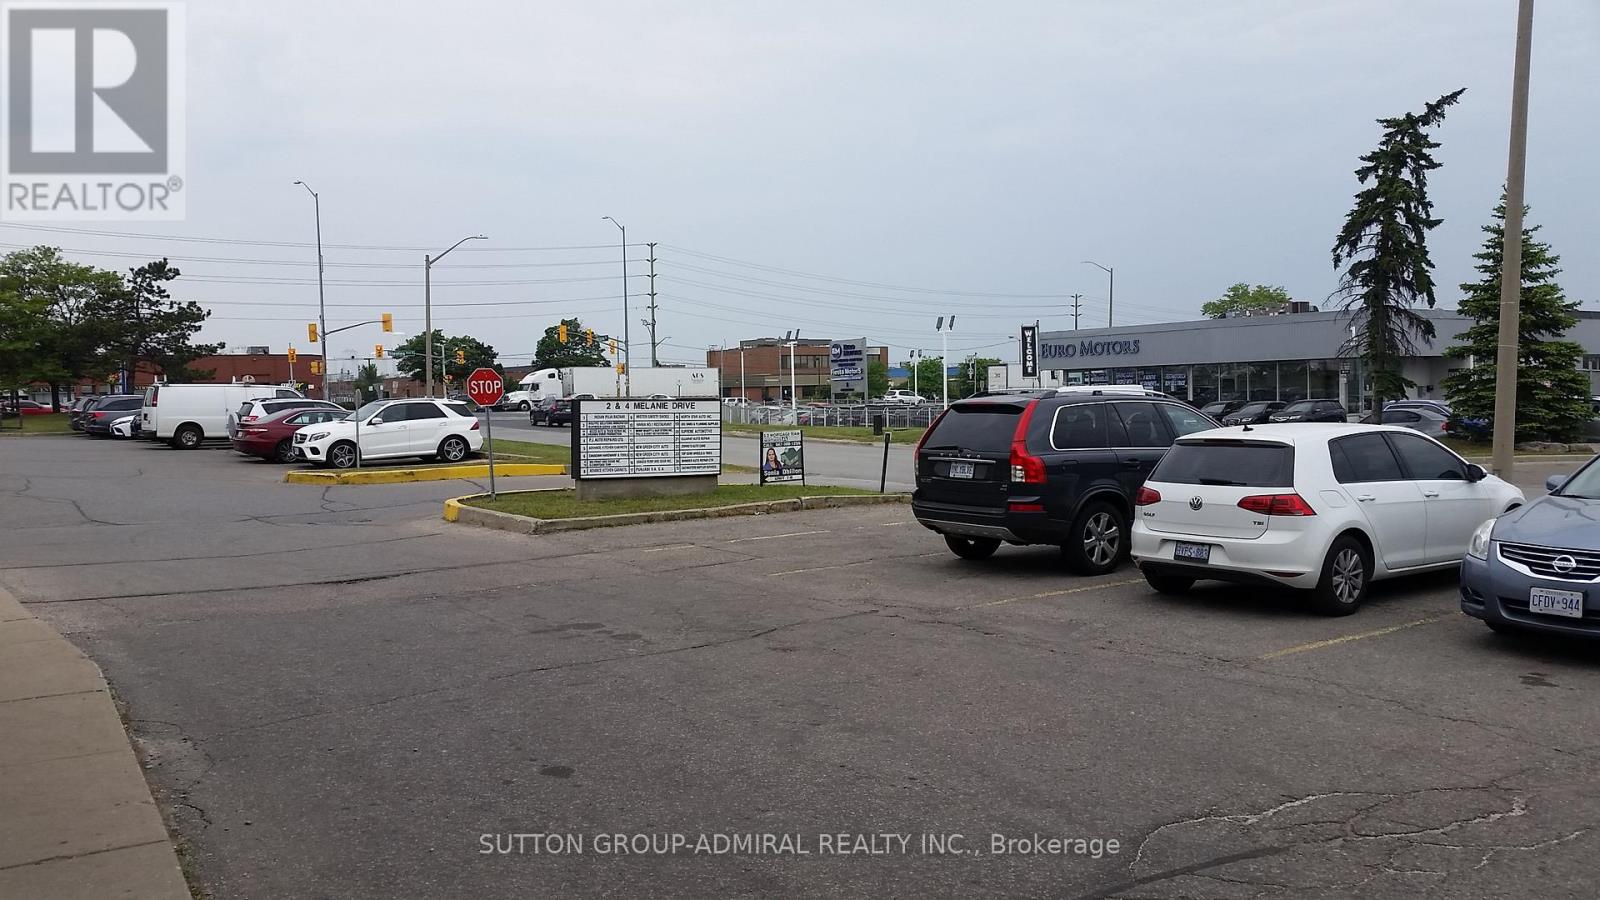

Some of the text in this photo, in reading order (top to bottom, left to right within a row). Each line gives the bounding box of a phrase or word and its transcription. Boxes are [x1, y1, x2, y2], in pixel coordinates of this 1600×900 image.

[1024, 330, 1033, 373] WELCOME
[1041, 339, 1140, 359] EURO MOTORS
[470, 380, 501, 395] STOP
[606, 402, 696, 410] 2 & 4 MELANIE DRIVE
